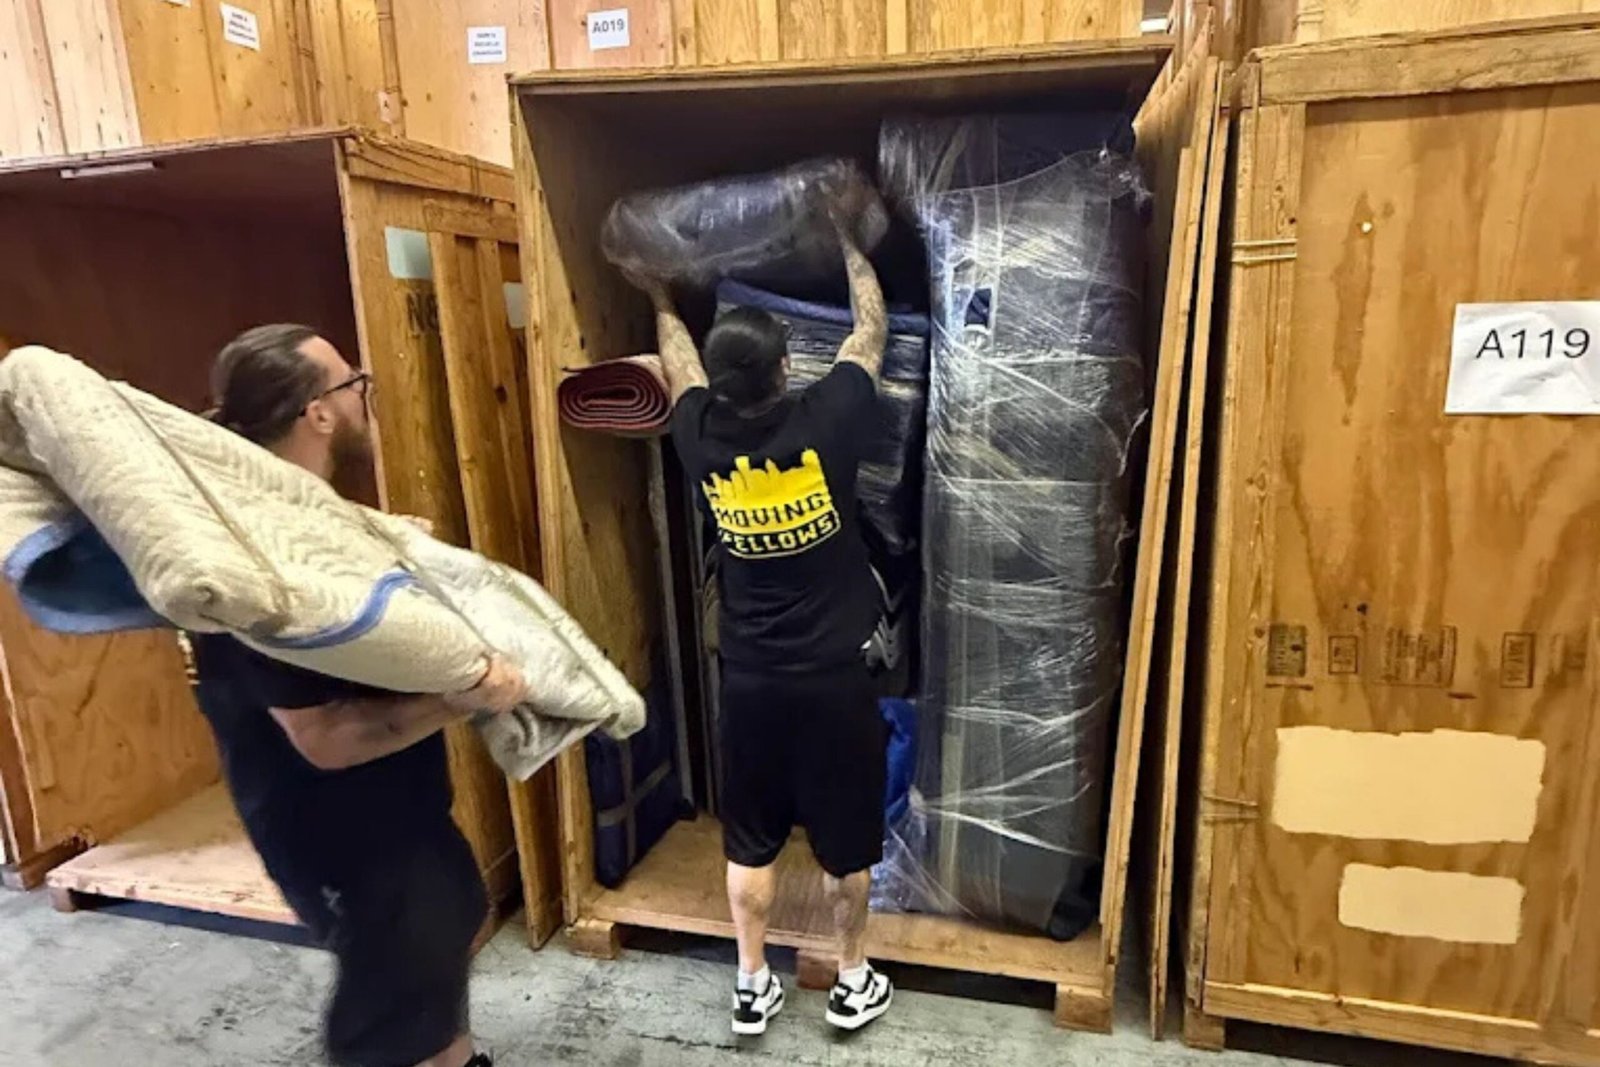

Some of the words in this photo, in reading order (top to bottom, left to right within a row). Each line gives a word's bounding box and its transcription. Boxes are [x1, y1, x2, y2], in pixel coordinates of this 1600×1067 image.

[592, 18, 624, 34] A019
[1475, 328, 1590, 359] A119
[715, 493, 825, 527] MOVING
[718, 515, 834, 552] FELLOWS
